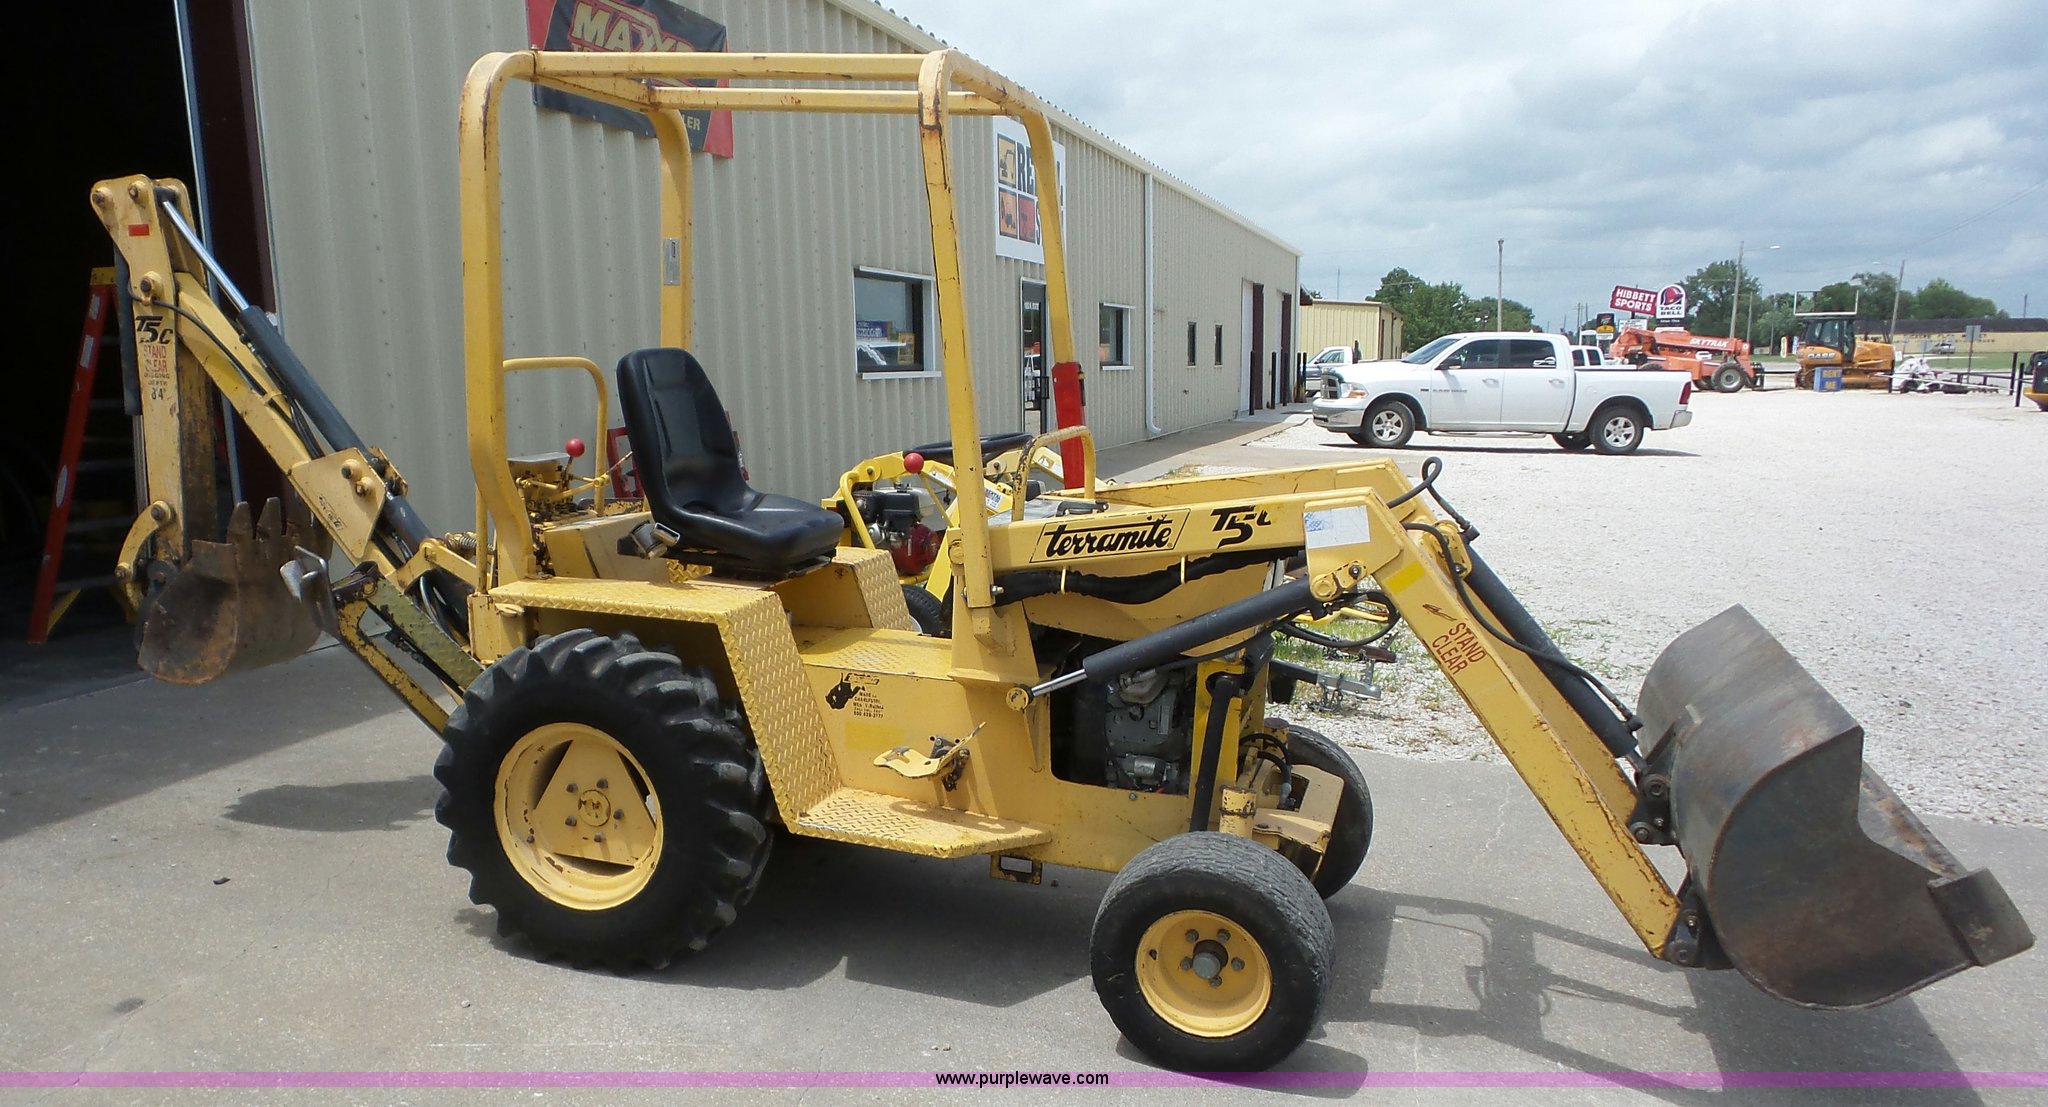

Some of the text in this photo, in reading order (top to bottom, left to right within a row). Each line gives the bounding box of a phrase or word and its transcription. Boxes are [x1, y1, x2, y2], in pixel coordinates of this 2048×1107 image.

[1616, 288, 1657, 303] HIBBETT
[1615, 298, 1653, 312] SPORTS
[1690, 338, 1730, 348] SKYTRAK
[1807, 351, 1836, 360] CASE
[1044, 514, 1173, 557] terramite
[1448, 622, 1487, 663] STAND
[1432, 634, 1468, 675] CLEAR
